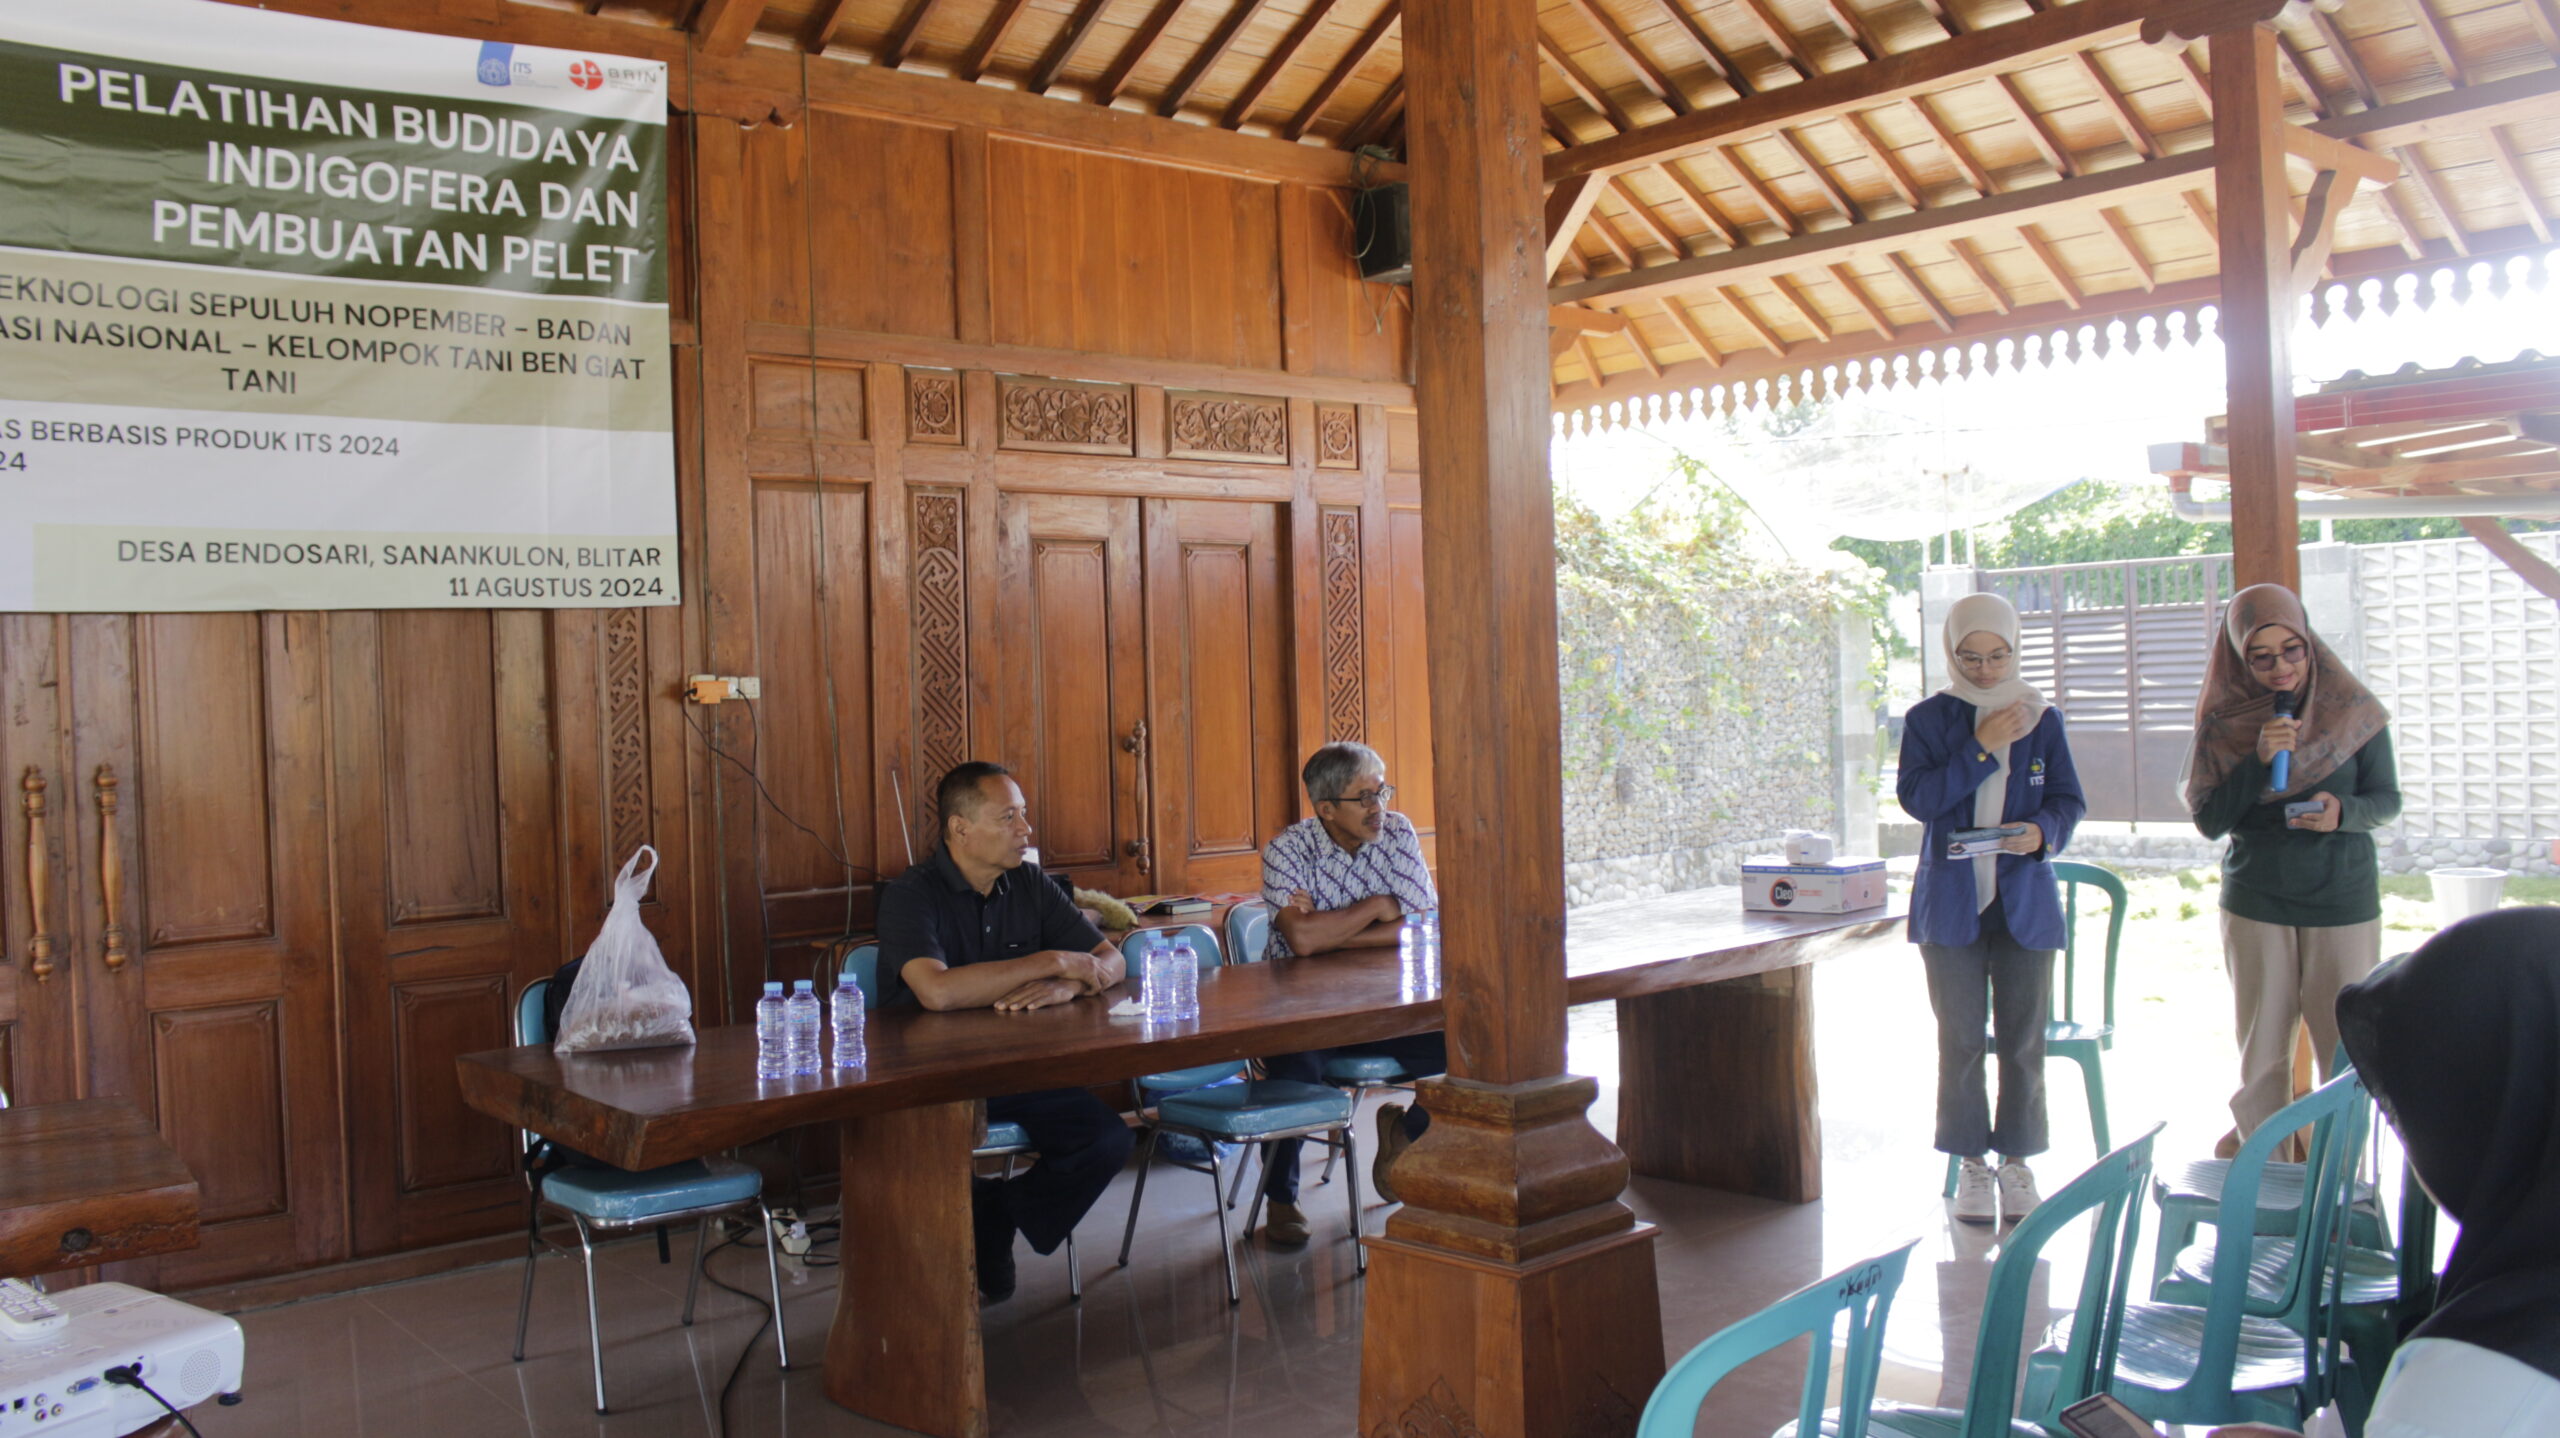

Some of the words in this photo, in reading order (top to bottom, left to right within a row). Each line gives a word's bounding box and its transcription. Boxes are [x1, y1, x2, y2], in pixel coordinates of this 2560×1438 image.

[513, 62, 532, 74] ITS
[608, 67, 657, 83] BRIN
[59, 63, 379, 139] PELATIHAN
[393, 105, 640, 173] BUDIDAYA
[208, 141, 528, 218] INDIGOFERA
[540, 182, 639, 228] DAN
[154, 200, 488, 273] PEMBUATAN
[503, 235, 639, 285] PELET
[190, 291, 334, 325] SEPULUH
[345, 303, 506, 338] NOPEMBER
[537, 318, 630, 346] BADAN
[54, 318, 232, 355] NASIONAL
[268, 334, 441, 368] KELOMPOK
[449, 346, 513, 372] TANI
[522, 351, 577, 375] BEN
[585, 355, 646, 380] GIAT
[221, 367, 297, 394] TANI
[31, 420, 168, 446] BERBASIS
[176, 427, 287, 451] PRODUK
[295, 432, 333, 453] ITS
[340, 434, 400, 456] 2024
[118, 540, 196, 563] DESA
[206, 542, 375, 568] BENDOSARI,
[382, 544, 570, 569] SANANKULON,
[577, 547, 662, 567] BLITAR
[450, 577, 469, 597] 11
[475, 577, 593, 597] AGUSTUS
[600, 577, 664, 597] 2024
[2030, 776, 2045, 786] ITS
[1775, 886, 1793, 900] Cleo
